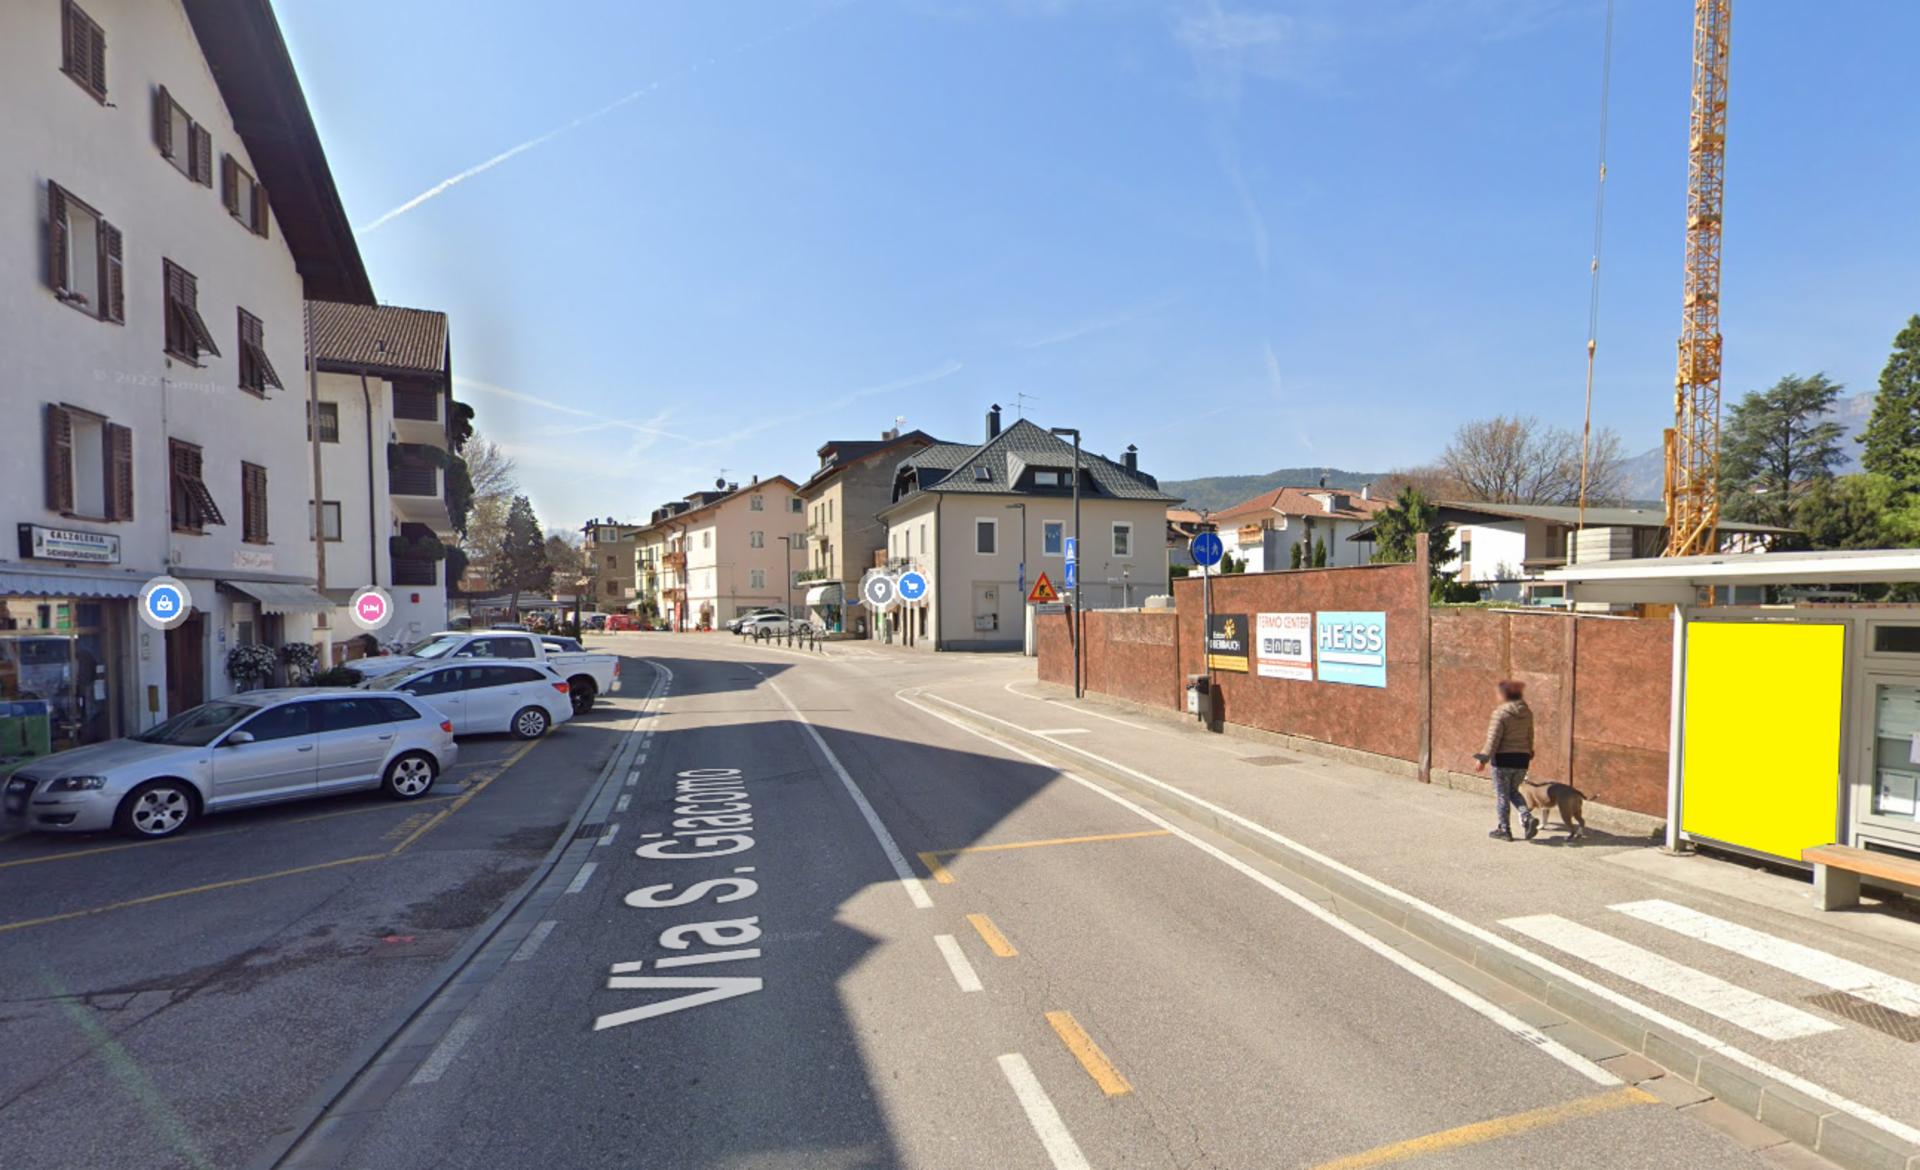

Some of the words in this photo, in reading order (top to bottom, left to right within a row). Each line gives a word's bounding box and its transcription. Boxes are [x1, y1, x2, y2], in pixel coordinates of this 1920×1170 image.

[50, 531, 104, 544] CALZOLERIA
[1284, 616, 1309, 629] CENTER
[635, 768, 755, 859] Giacomo
[624, 866, 759, 908] S.
[593, 915, 763, 1031] Via
